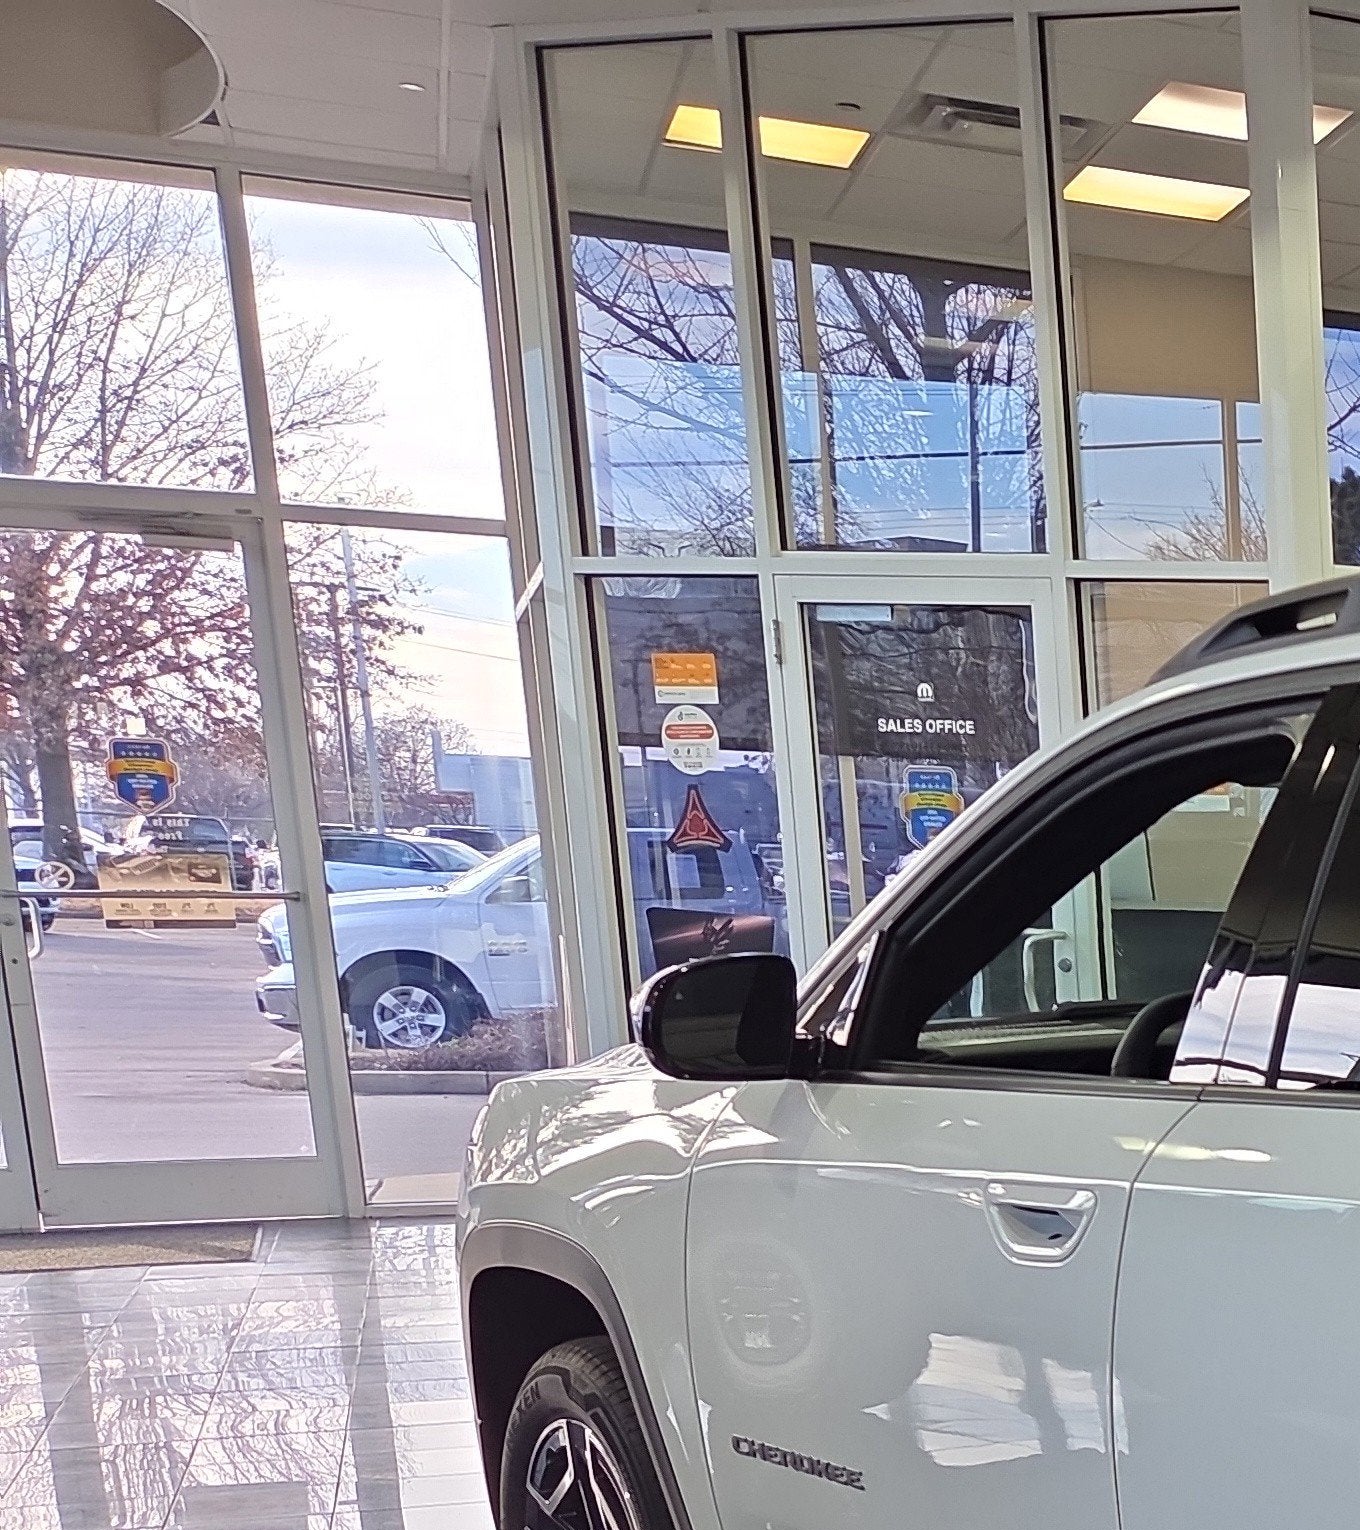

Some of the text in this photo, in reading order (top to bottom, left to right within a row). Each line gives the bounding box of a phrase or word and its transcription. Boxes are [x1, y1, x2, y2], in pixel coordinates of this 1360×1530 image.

[877, 718, 976, 734] SALES OFFICE
[731, 1435, 867, 1491] CHEROKEE
